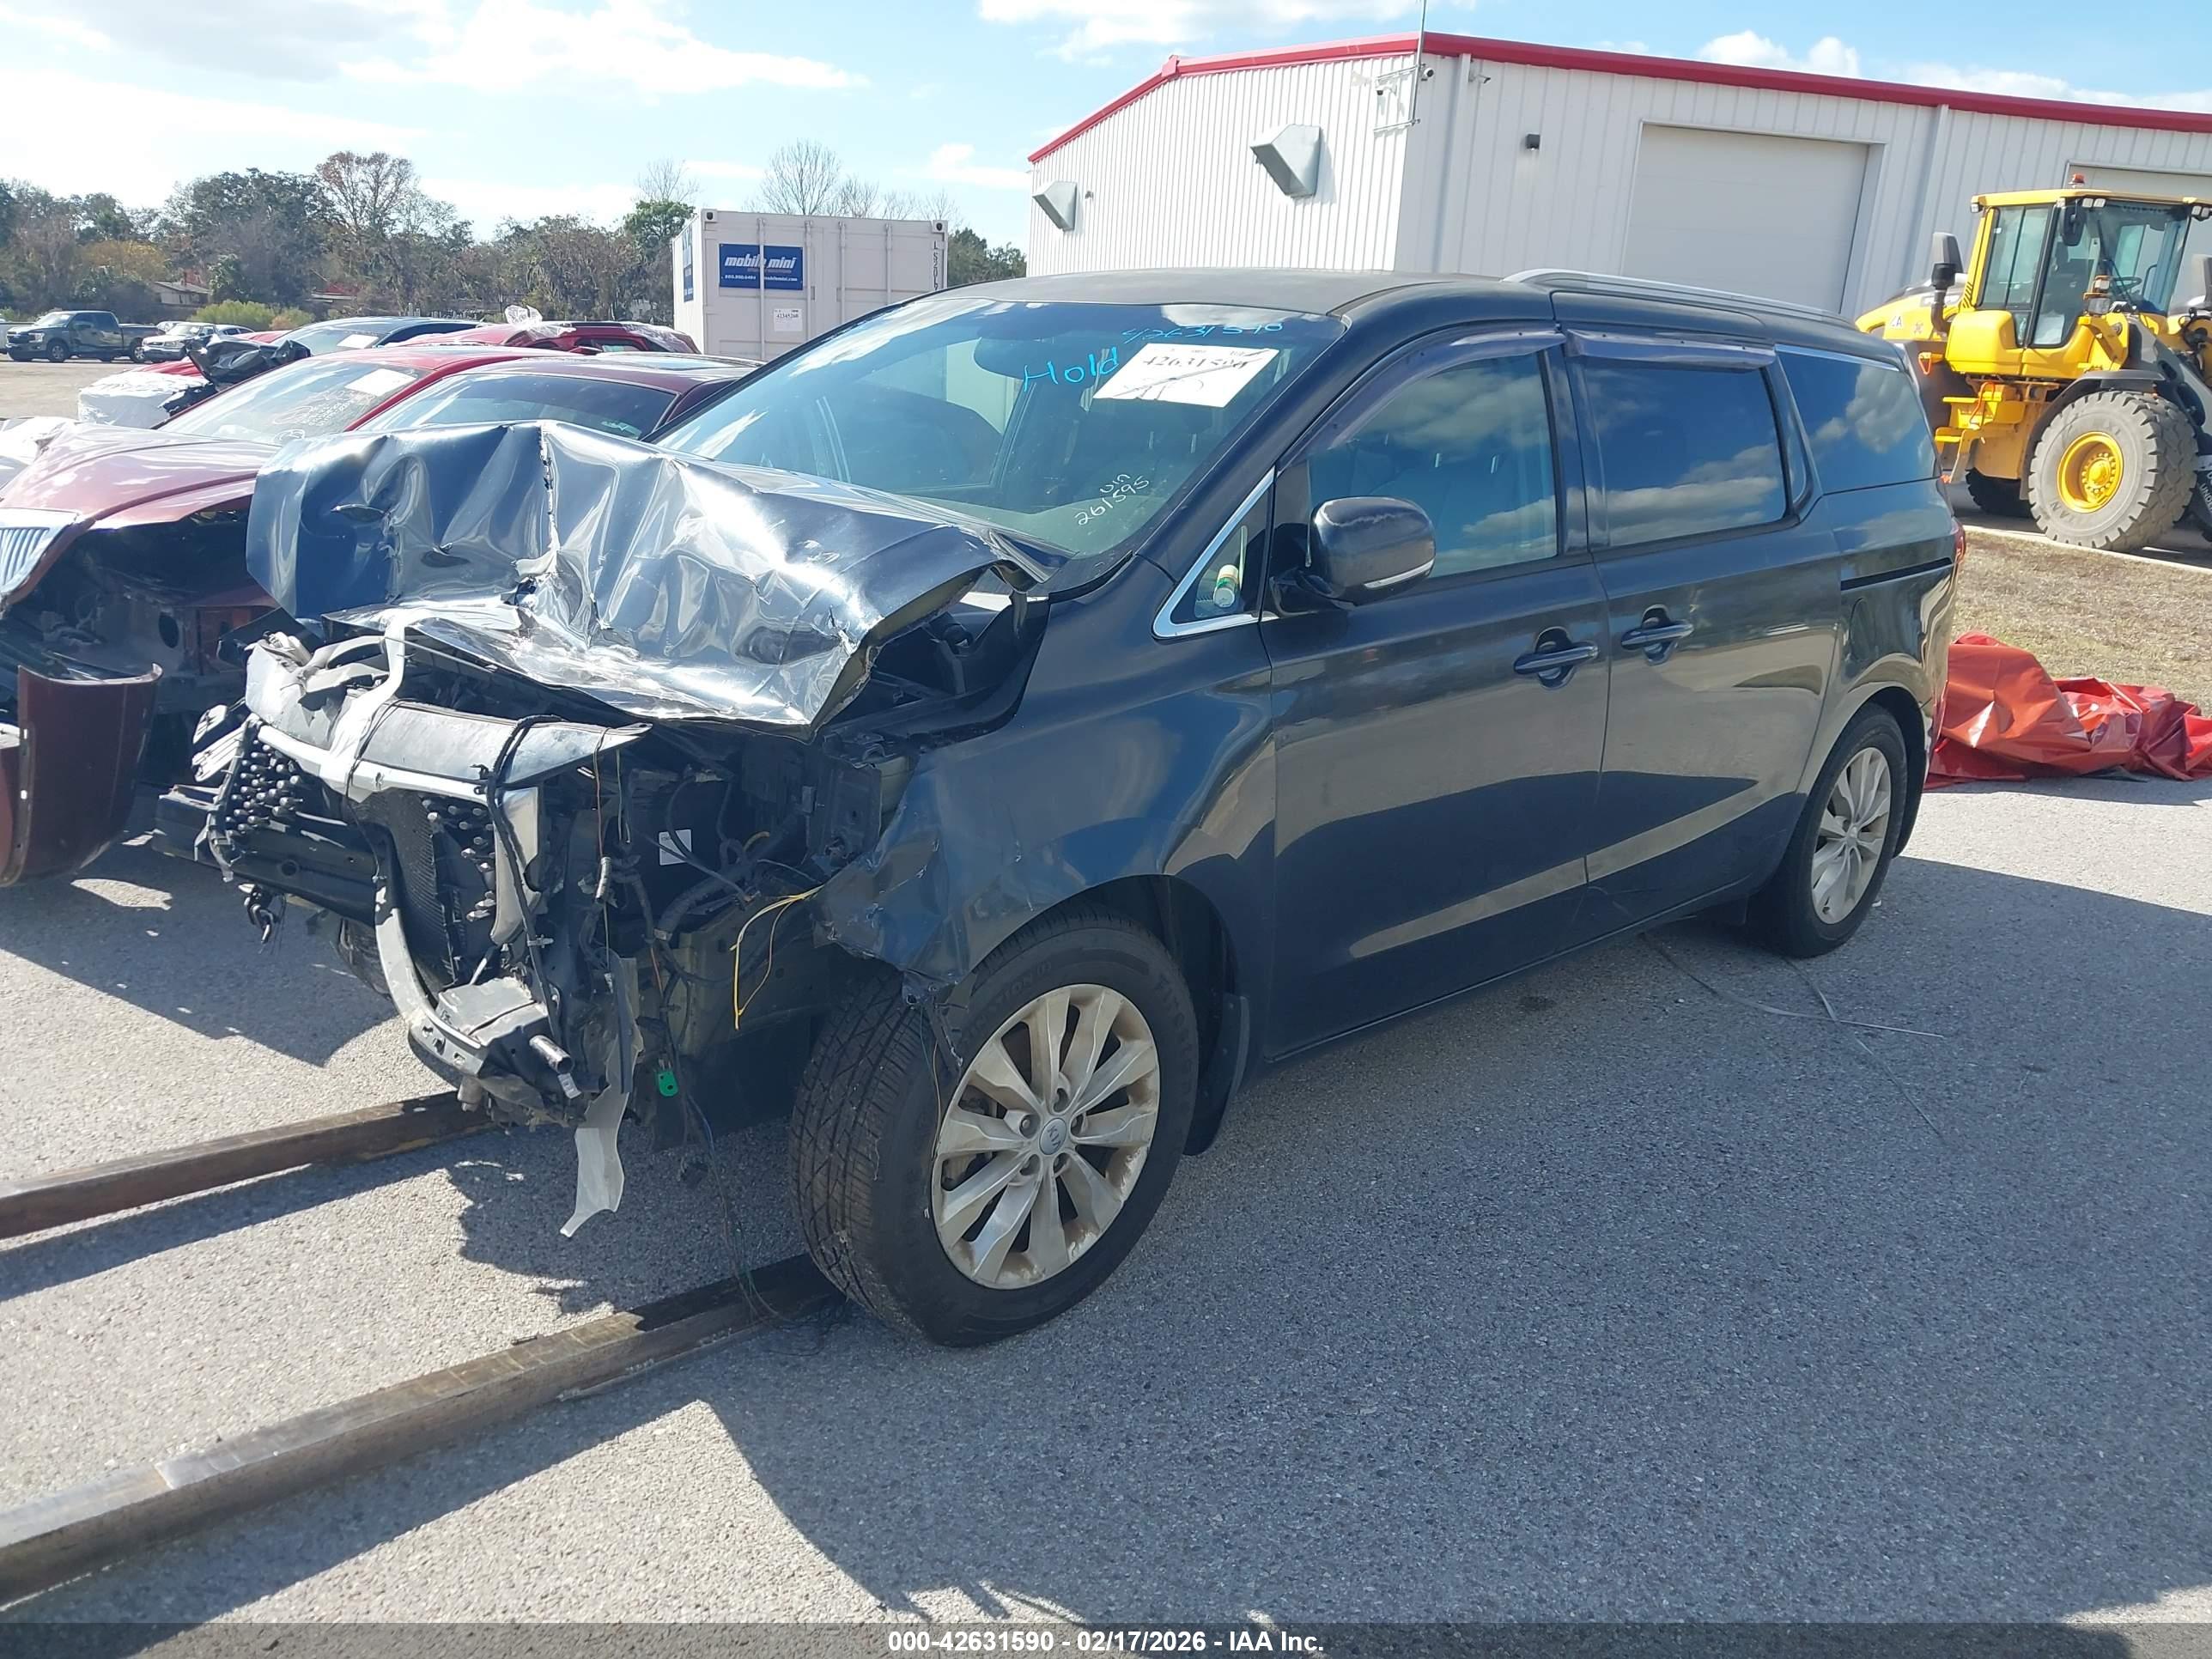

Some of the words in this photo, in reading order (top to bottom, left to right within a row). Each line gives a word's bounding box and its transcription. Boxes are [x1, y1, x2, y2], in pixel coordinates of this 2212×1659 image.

[767, 257, 797, 269] mini
[1024, 346, 1120, 392] Hold
[1074, 475, 1150, 526] 261595
[1047, 1125, 1061, 1152] KIA
